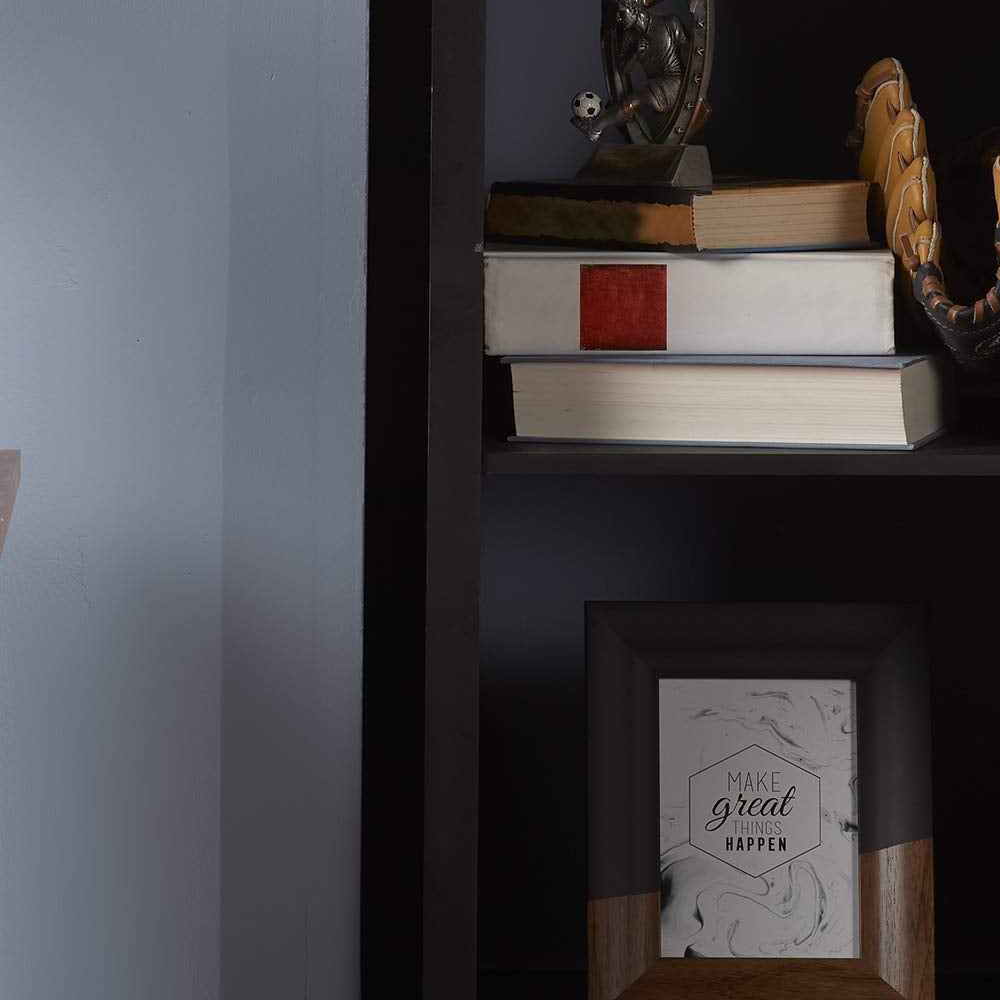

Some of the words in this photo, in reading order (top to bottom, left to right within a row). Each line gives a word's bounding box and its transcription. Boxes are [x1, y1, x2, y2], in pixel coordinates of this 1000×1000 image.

[727, 771, 782, 793] MAKE
[704, 785, 797, 833] great
[731, 820, 783, 836] THINGS
[725, 836, 787, 852] HAPPEN
